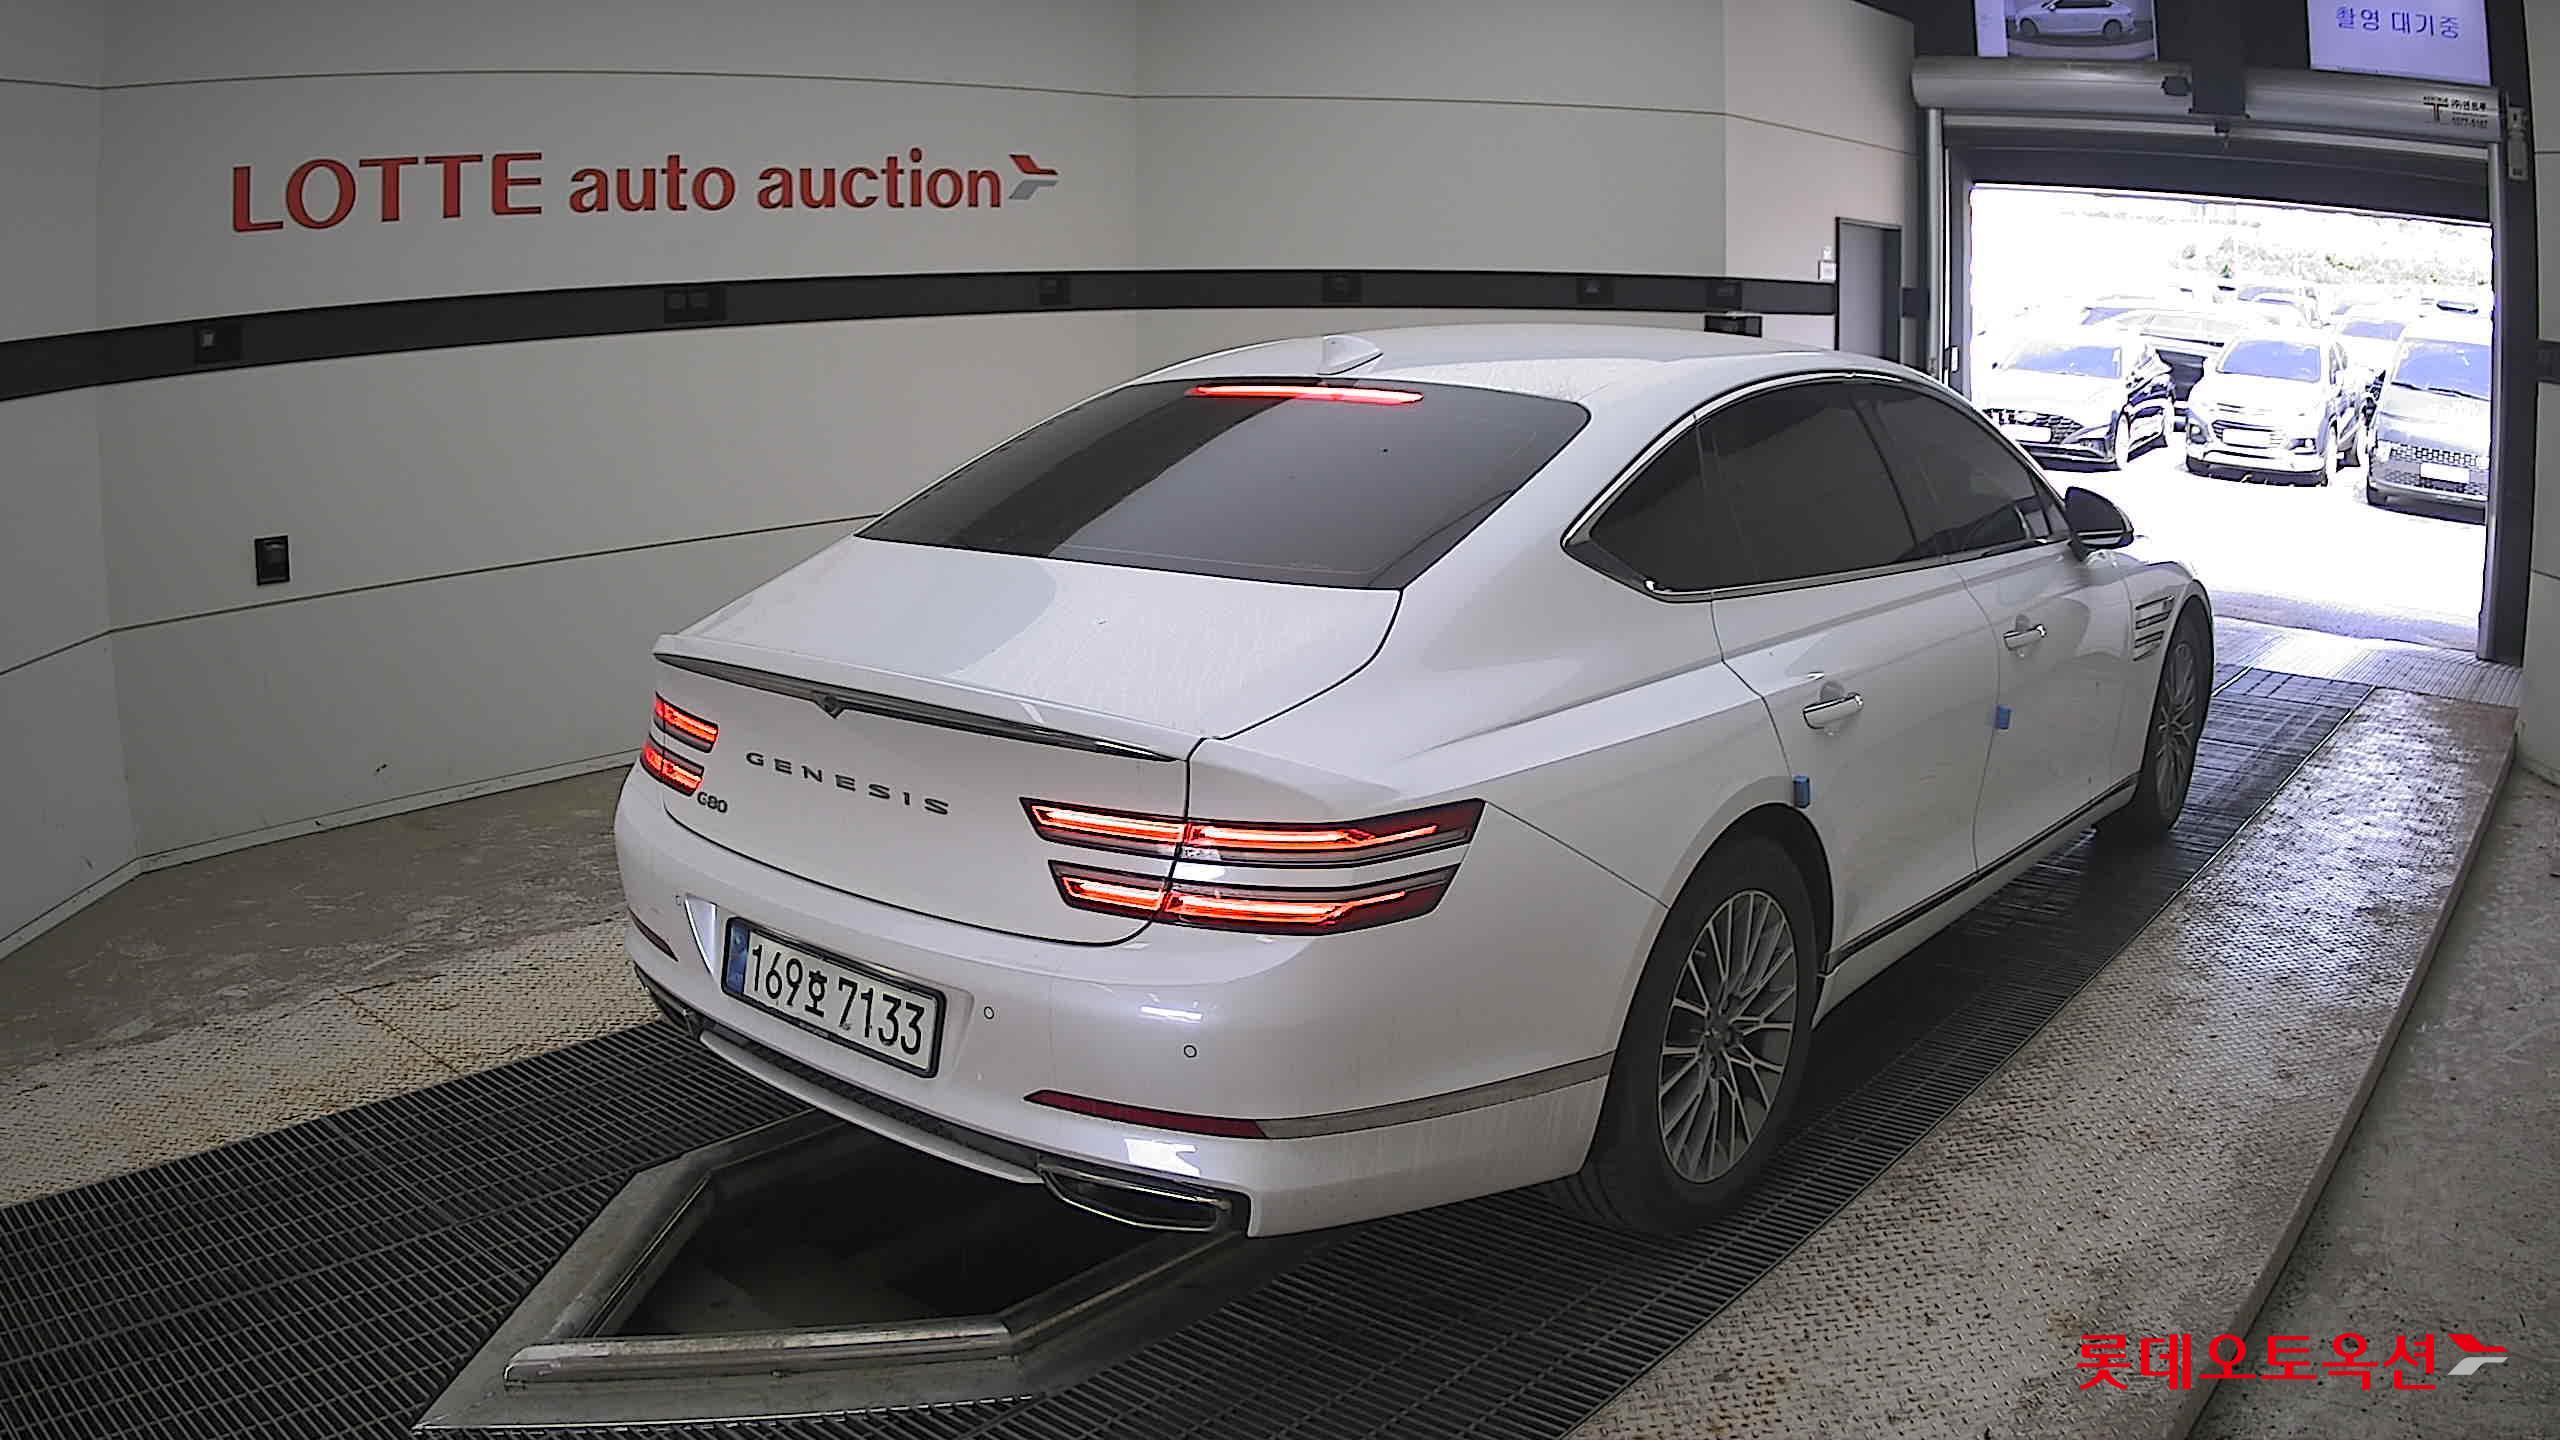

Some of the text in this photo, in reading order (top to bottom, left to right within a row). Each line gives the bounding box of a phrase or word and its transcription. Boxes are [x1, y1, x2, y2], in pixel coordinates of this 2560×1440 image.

[2336, 6, 2459, 39] 촬영 대기중
[233, 148, 1003, 233] LOTTE auto auction
[697, 791, 728, 813] G80
[745, 752, 949, 816] GENESIS
